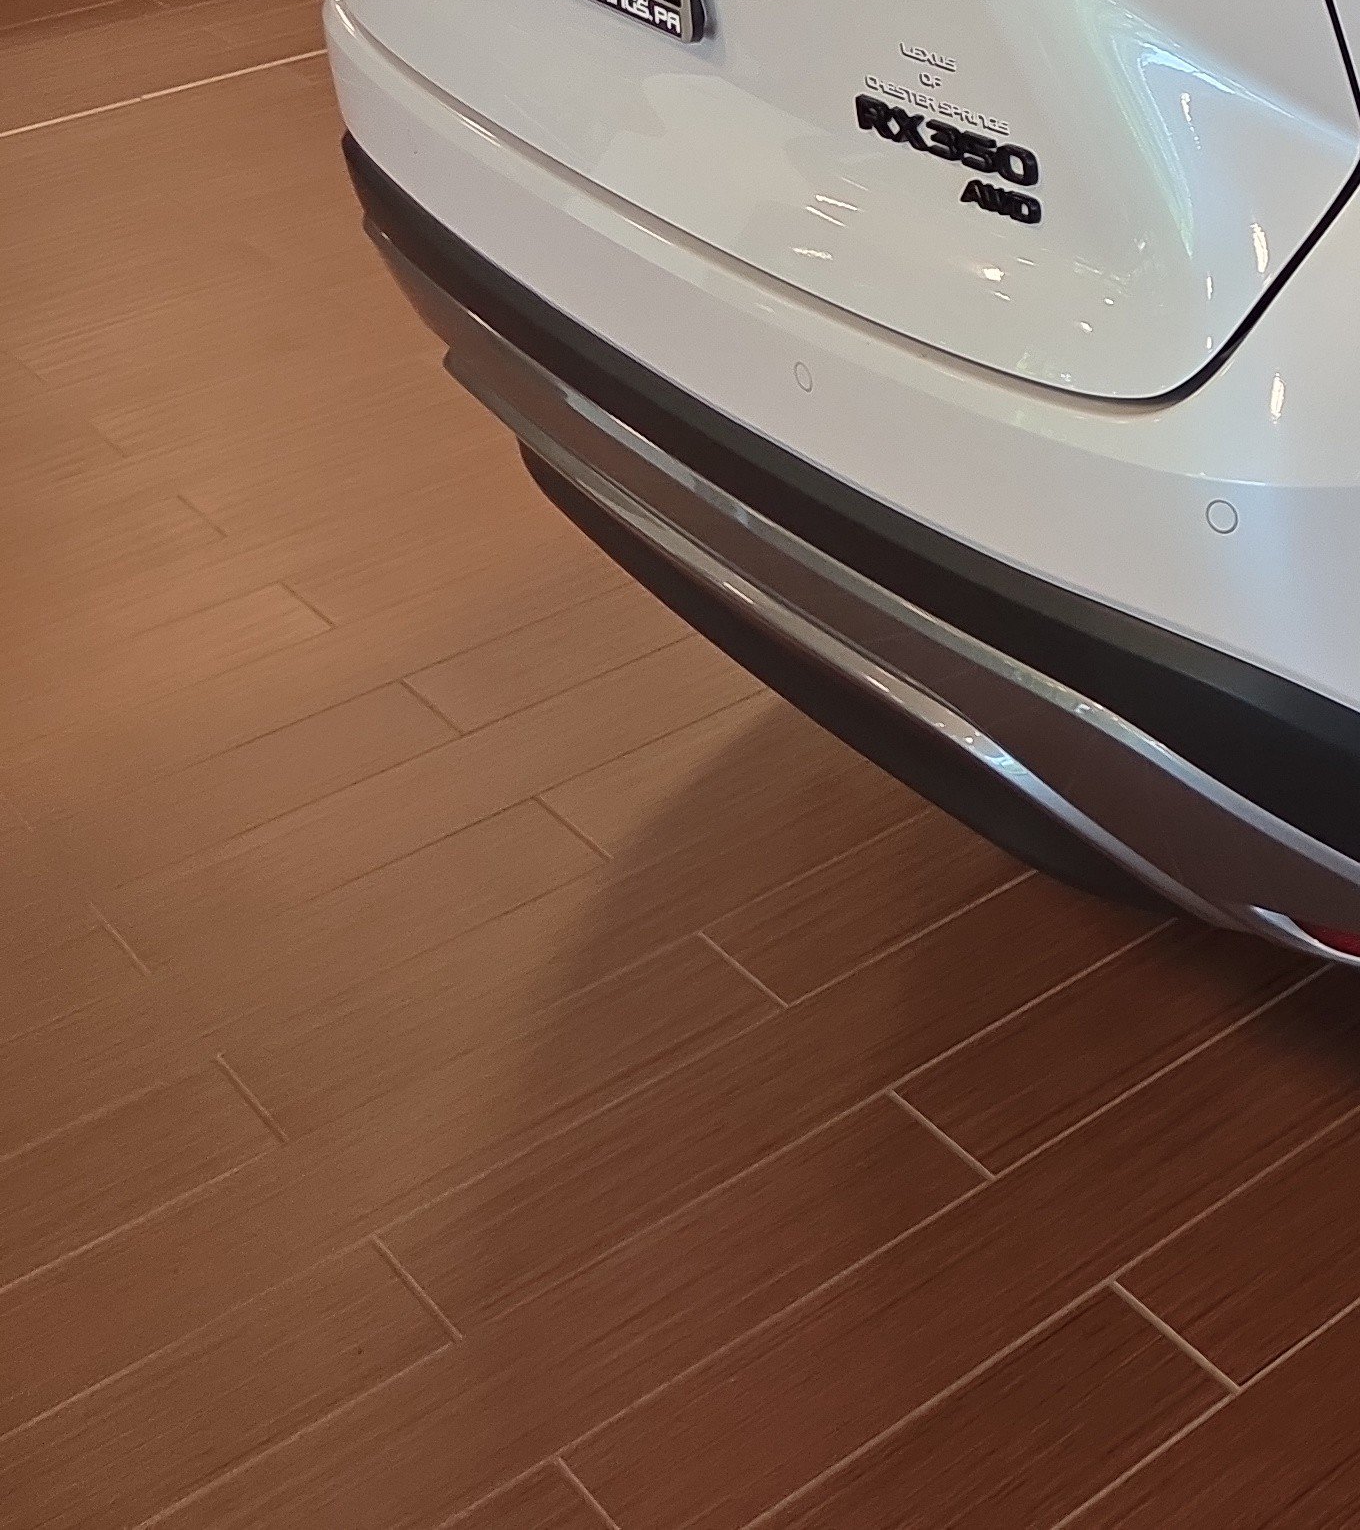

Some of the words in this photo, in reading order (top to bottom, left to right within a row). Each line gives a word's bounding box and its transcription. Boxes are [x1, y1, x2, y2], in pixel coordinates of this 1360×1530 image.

[653, 4, 681, 34] PA
[899, 41, 957, 73] LEXUS
[918, 71, 942, 89] OF
[864, 74, 937, 113] CHESTER
[937, 101, 1010, 137] SPRINGS
[855, 93, 1040, 187] RX350
[959, 178, 1042, 225] AWD
